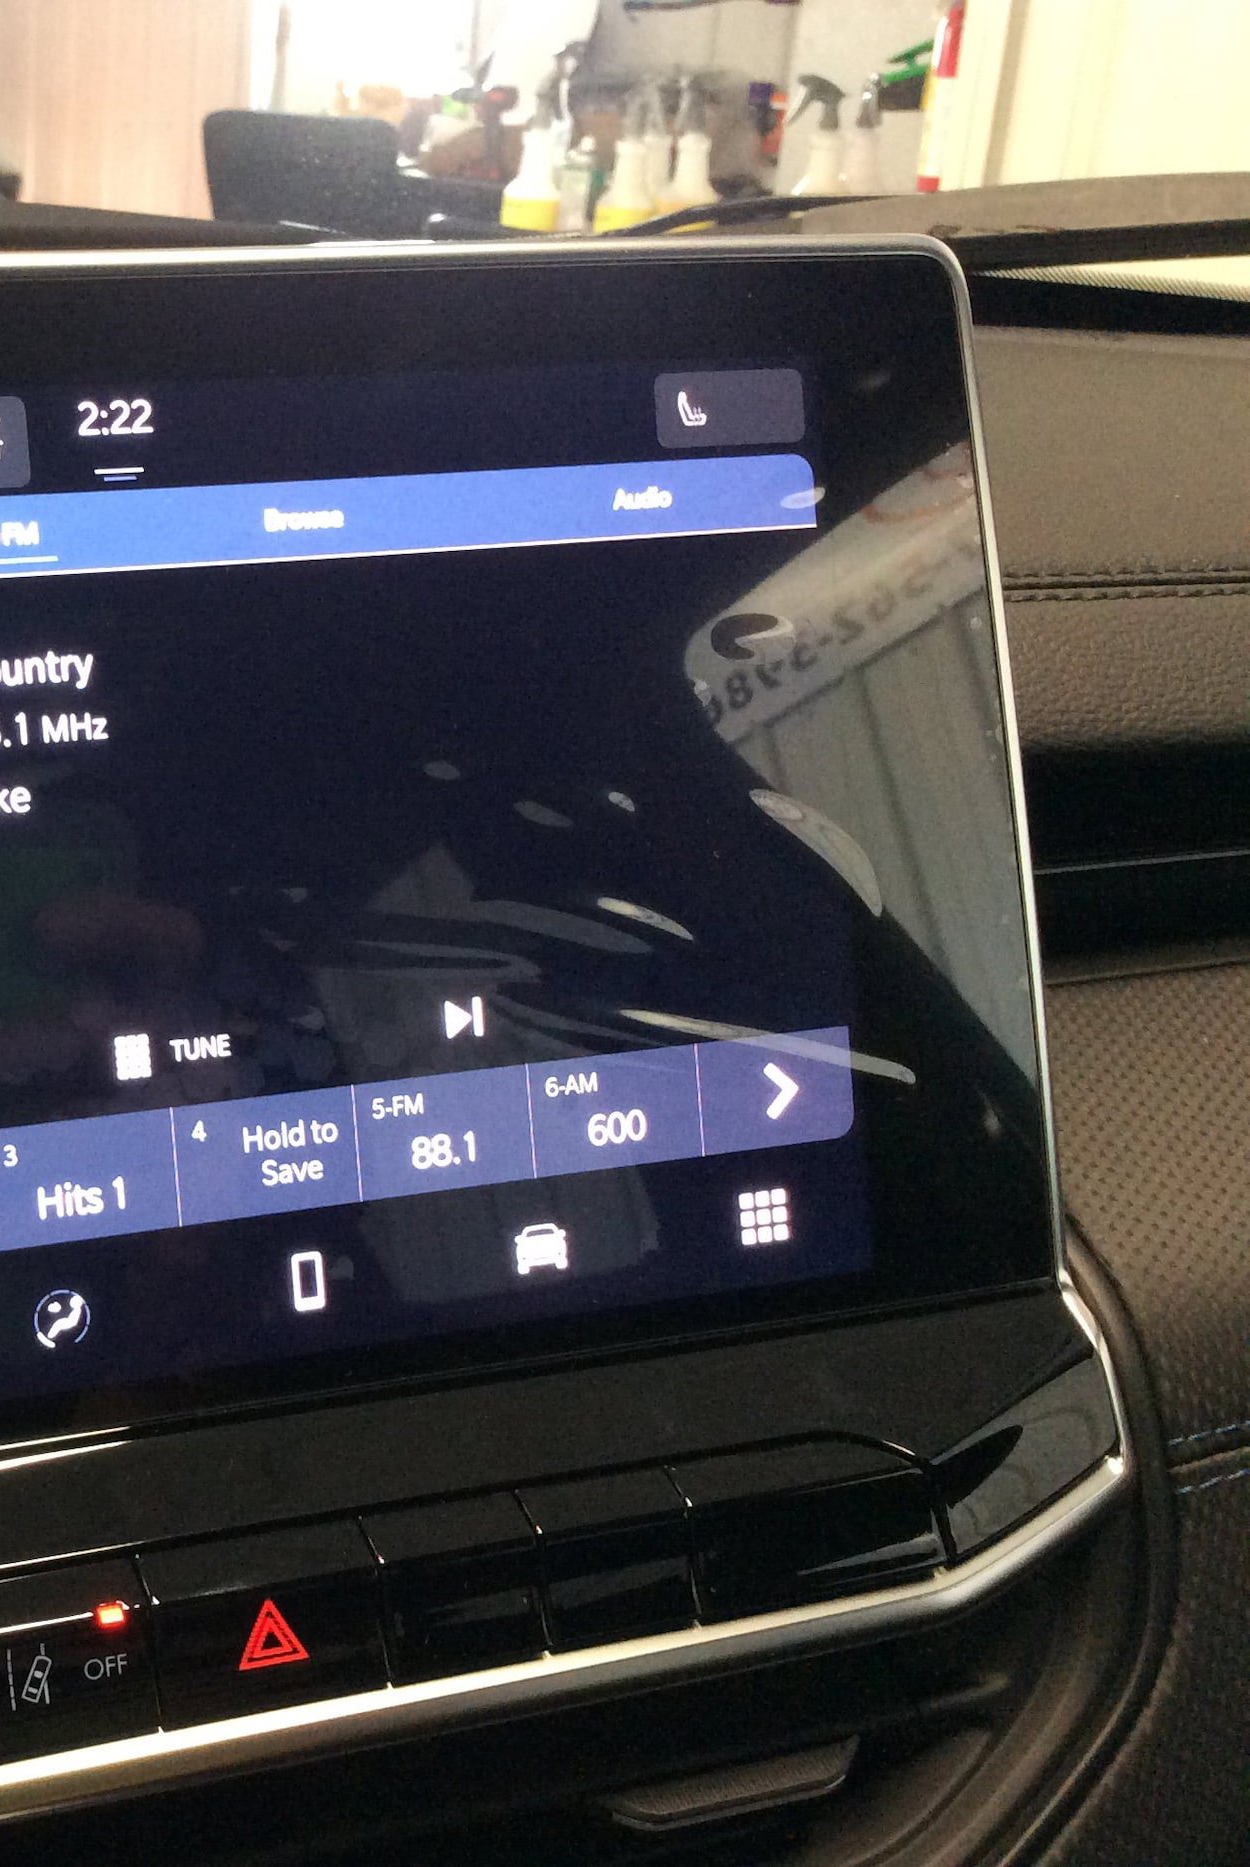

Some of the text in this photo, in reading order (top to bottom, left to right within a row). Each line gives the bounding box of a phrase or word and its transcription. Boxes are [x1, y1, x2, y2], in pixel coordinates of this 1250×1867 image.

[77, 398, 154, 437] 2:22
[612, 485, 673, 511] Audio
[1, 520, 40, 547] FM
[263, 507, 345, 533] Browse
[41, 712, 109, 744] MHz
[168, 1033, 232, 1063] TUNE
[544, 1071, 598, 1098] 6-AM
[371, 1092, 425, 1120] 5-FM
[191, 1120, 208, 1142] 4
[242, 1119, 339, 1154] Hold to
[587, 1108, 647, 1147] 600
[3, 1144, 19, 1167] 3
[411, 1130, 476, 1170] 88.1
[261, 1159, 324, 1187] Save
[36, 1175, 126, 1221] Hits 1
[84, 1653, 128, 1681] OFF
